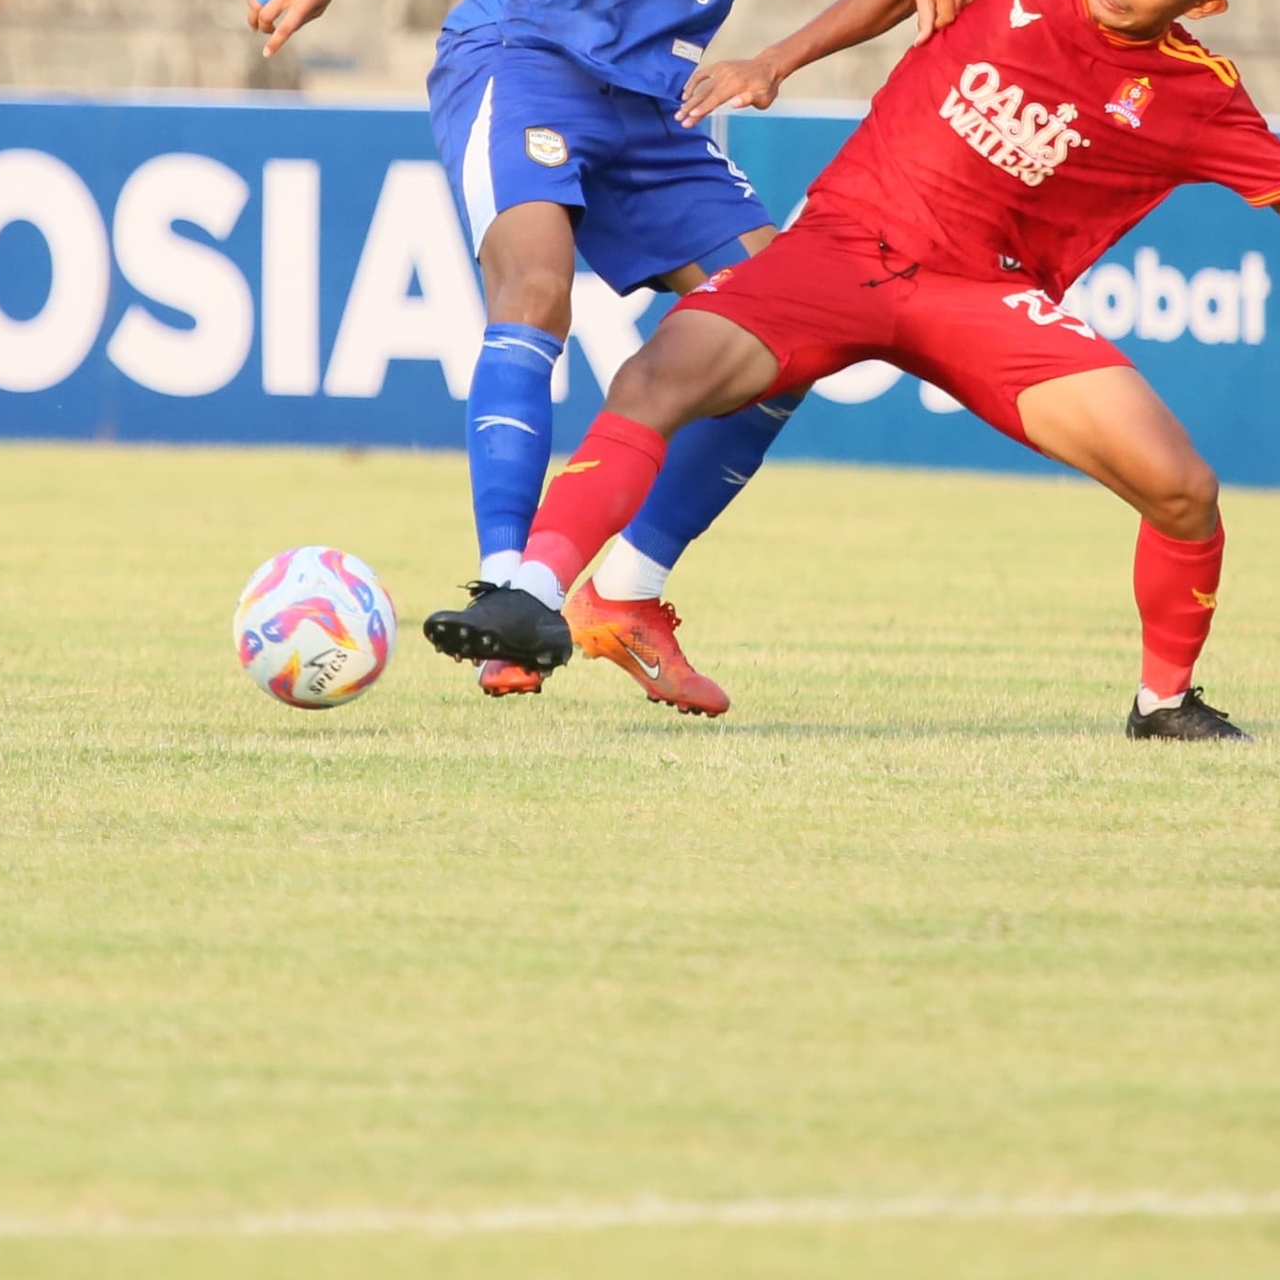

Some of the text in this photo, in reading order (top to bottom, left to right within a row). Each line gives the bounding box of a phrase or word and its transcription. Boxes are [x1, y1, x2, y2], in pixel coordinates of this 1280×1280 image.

[939, 85, 1054, 187] WATERS
[960, 62, 1081, 167] OASIS
[1061, 247, 1270, 345] obat
[308, 649, 348, 695] SPECS
